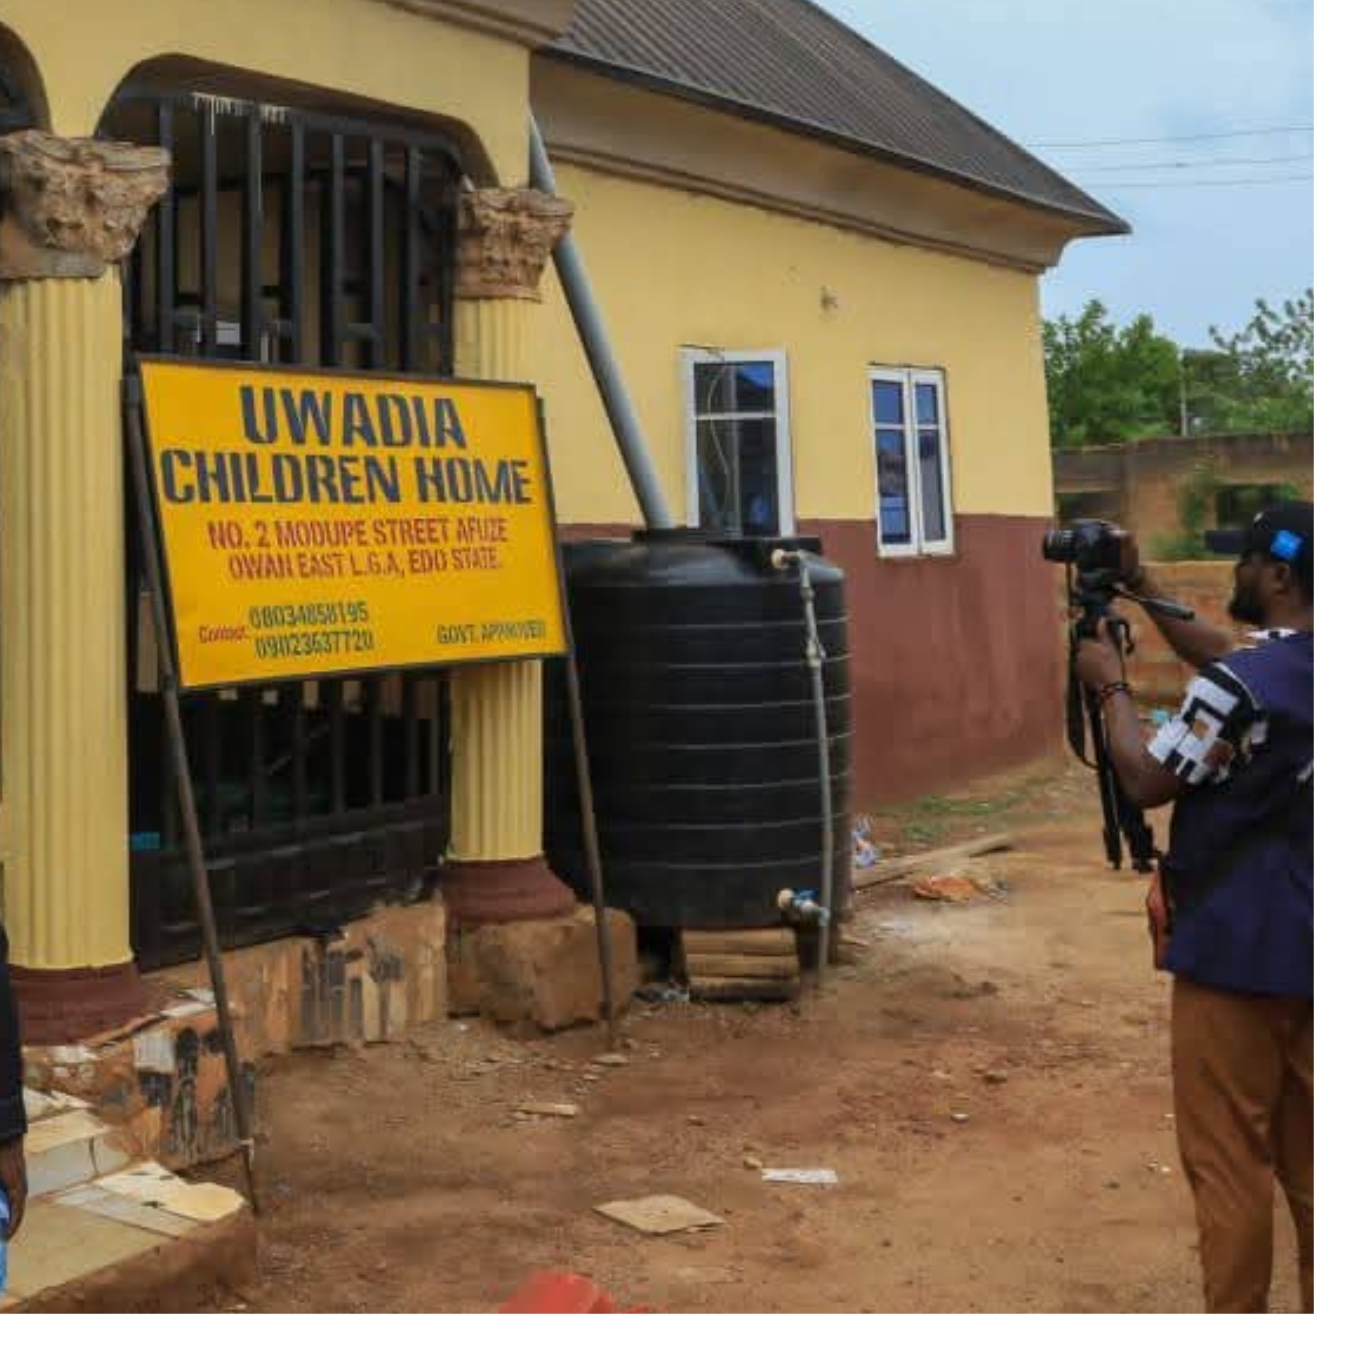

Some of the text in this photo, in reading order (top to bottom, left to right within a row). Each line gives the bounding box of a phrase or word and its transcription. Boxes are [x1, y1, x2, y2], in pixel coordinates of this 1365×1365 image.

[239, 384, 468, 450] UWADIA
[158, 449, 532, 505] CHILDREN HOME
[207, 521, 250, 550] NO.
[254, 520, 271, 548] 2
[273, 519, 369, 548] MODUPE
[372, 517, 449, 546] STREET
[228, 552, 293, 580] OWAN
[296, 552, 344, 578] EAST
[408, 548, 448, 574] EDO
